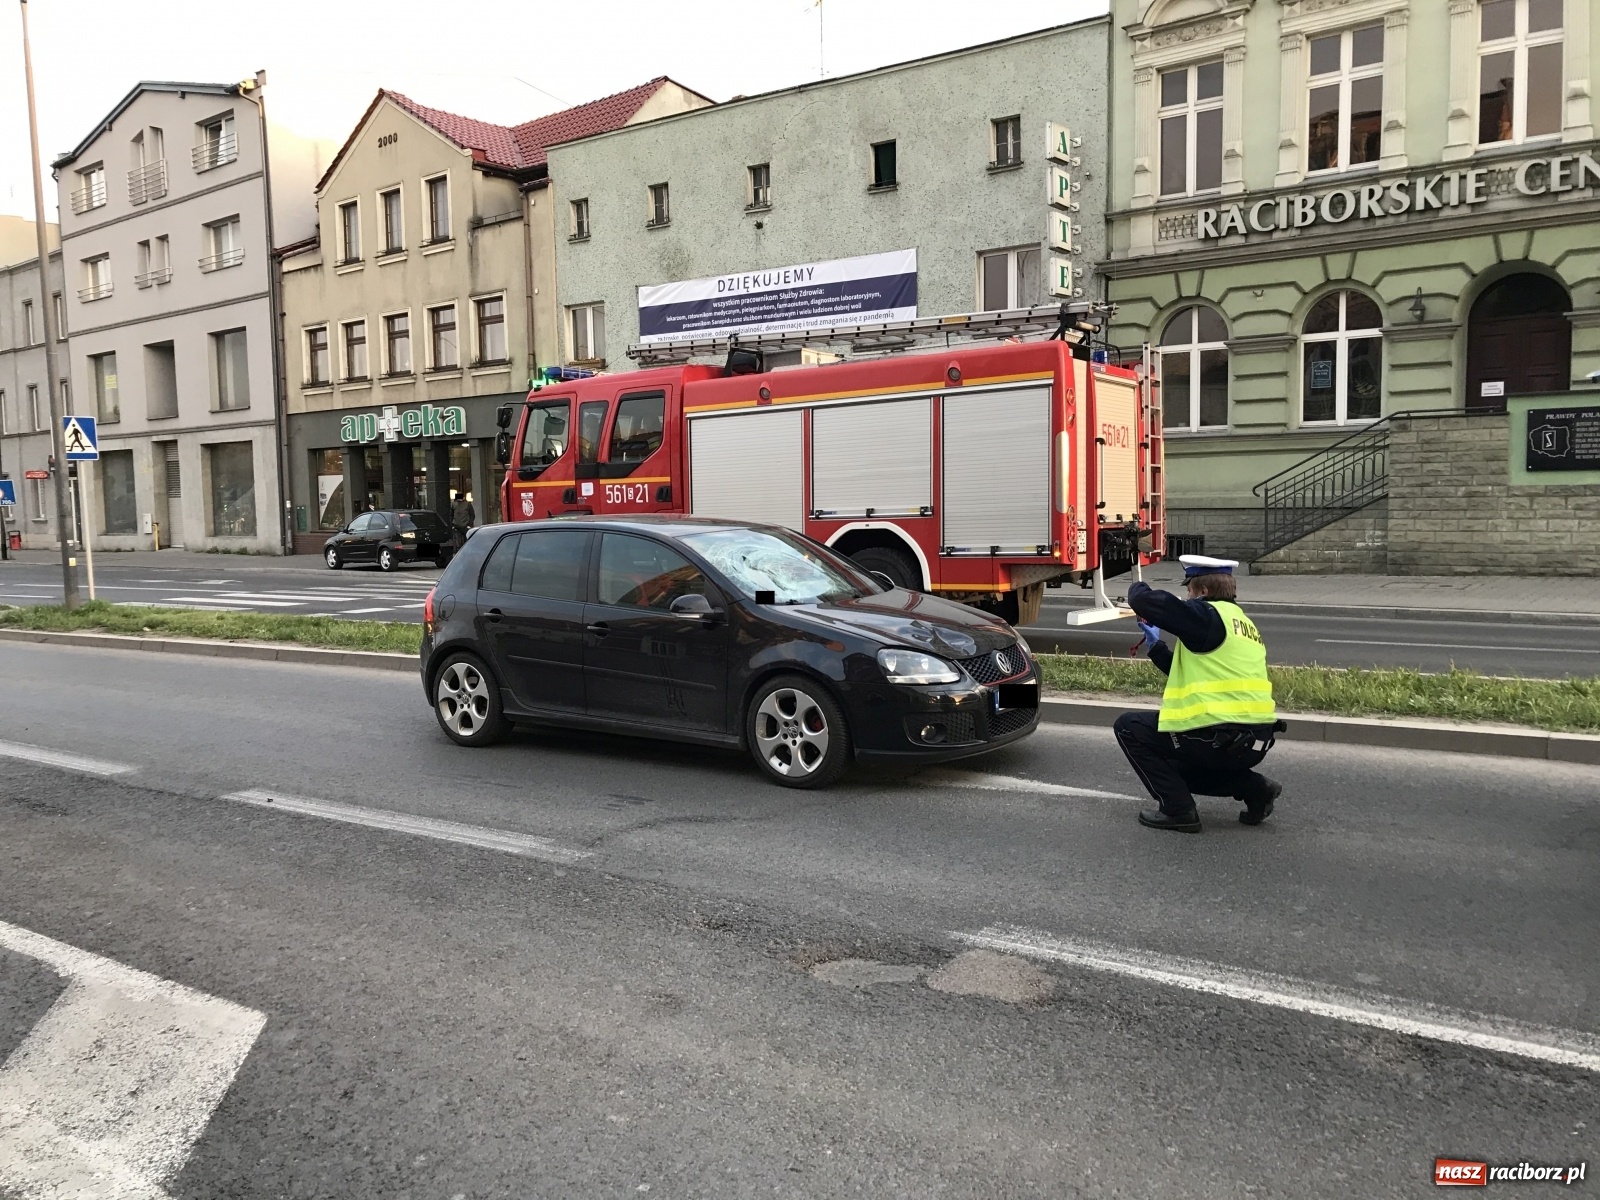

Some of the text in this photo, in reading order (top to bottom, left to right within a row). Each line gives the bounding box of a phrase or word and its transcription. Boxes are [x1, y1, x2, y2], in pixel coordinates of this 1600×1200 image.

[378, 133, 398, 148] 2000
[1197, 168, 1488, 240] RACIBORSKIE
[718, 267, 815, 293] DZIĘKUJEMY
[713, 288, 825, 308] wszystkim pracownikom Służby Zdrowia:
[806, 319, 818, 327] trud
[819, 316, 848, 326] zmagania
[849, 315, 858, 324] się
[863, 310, 895, 323] pandemią
